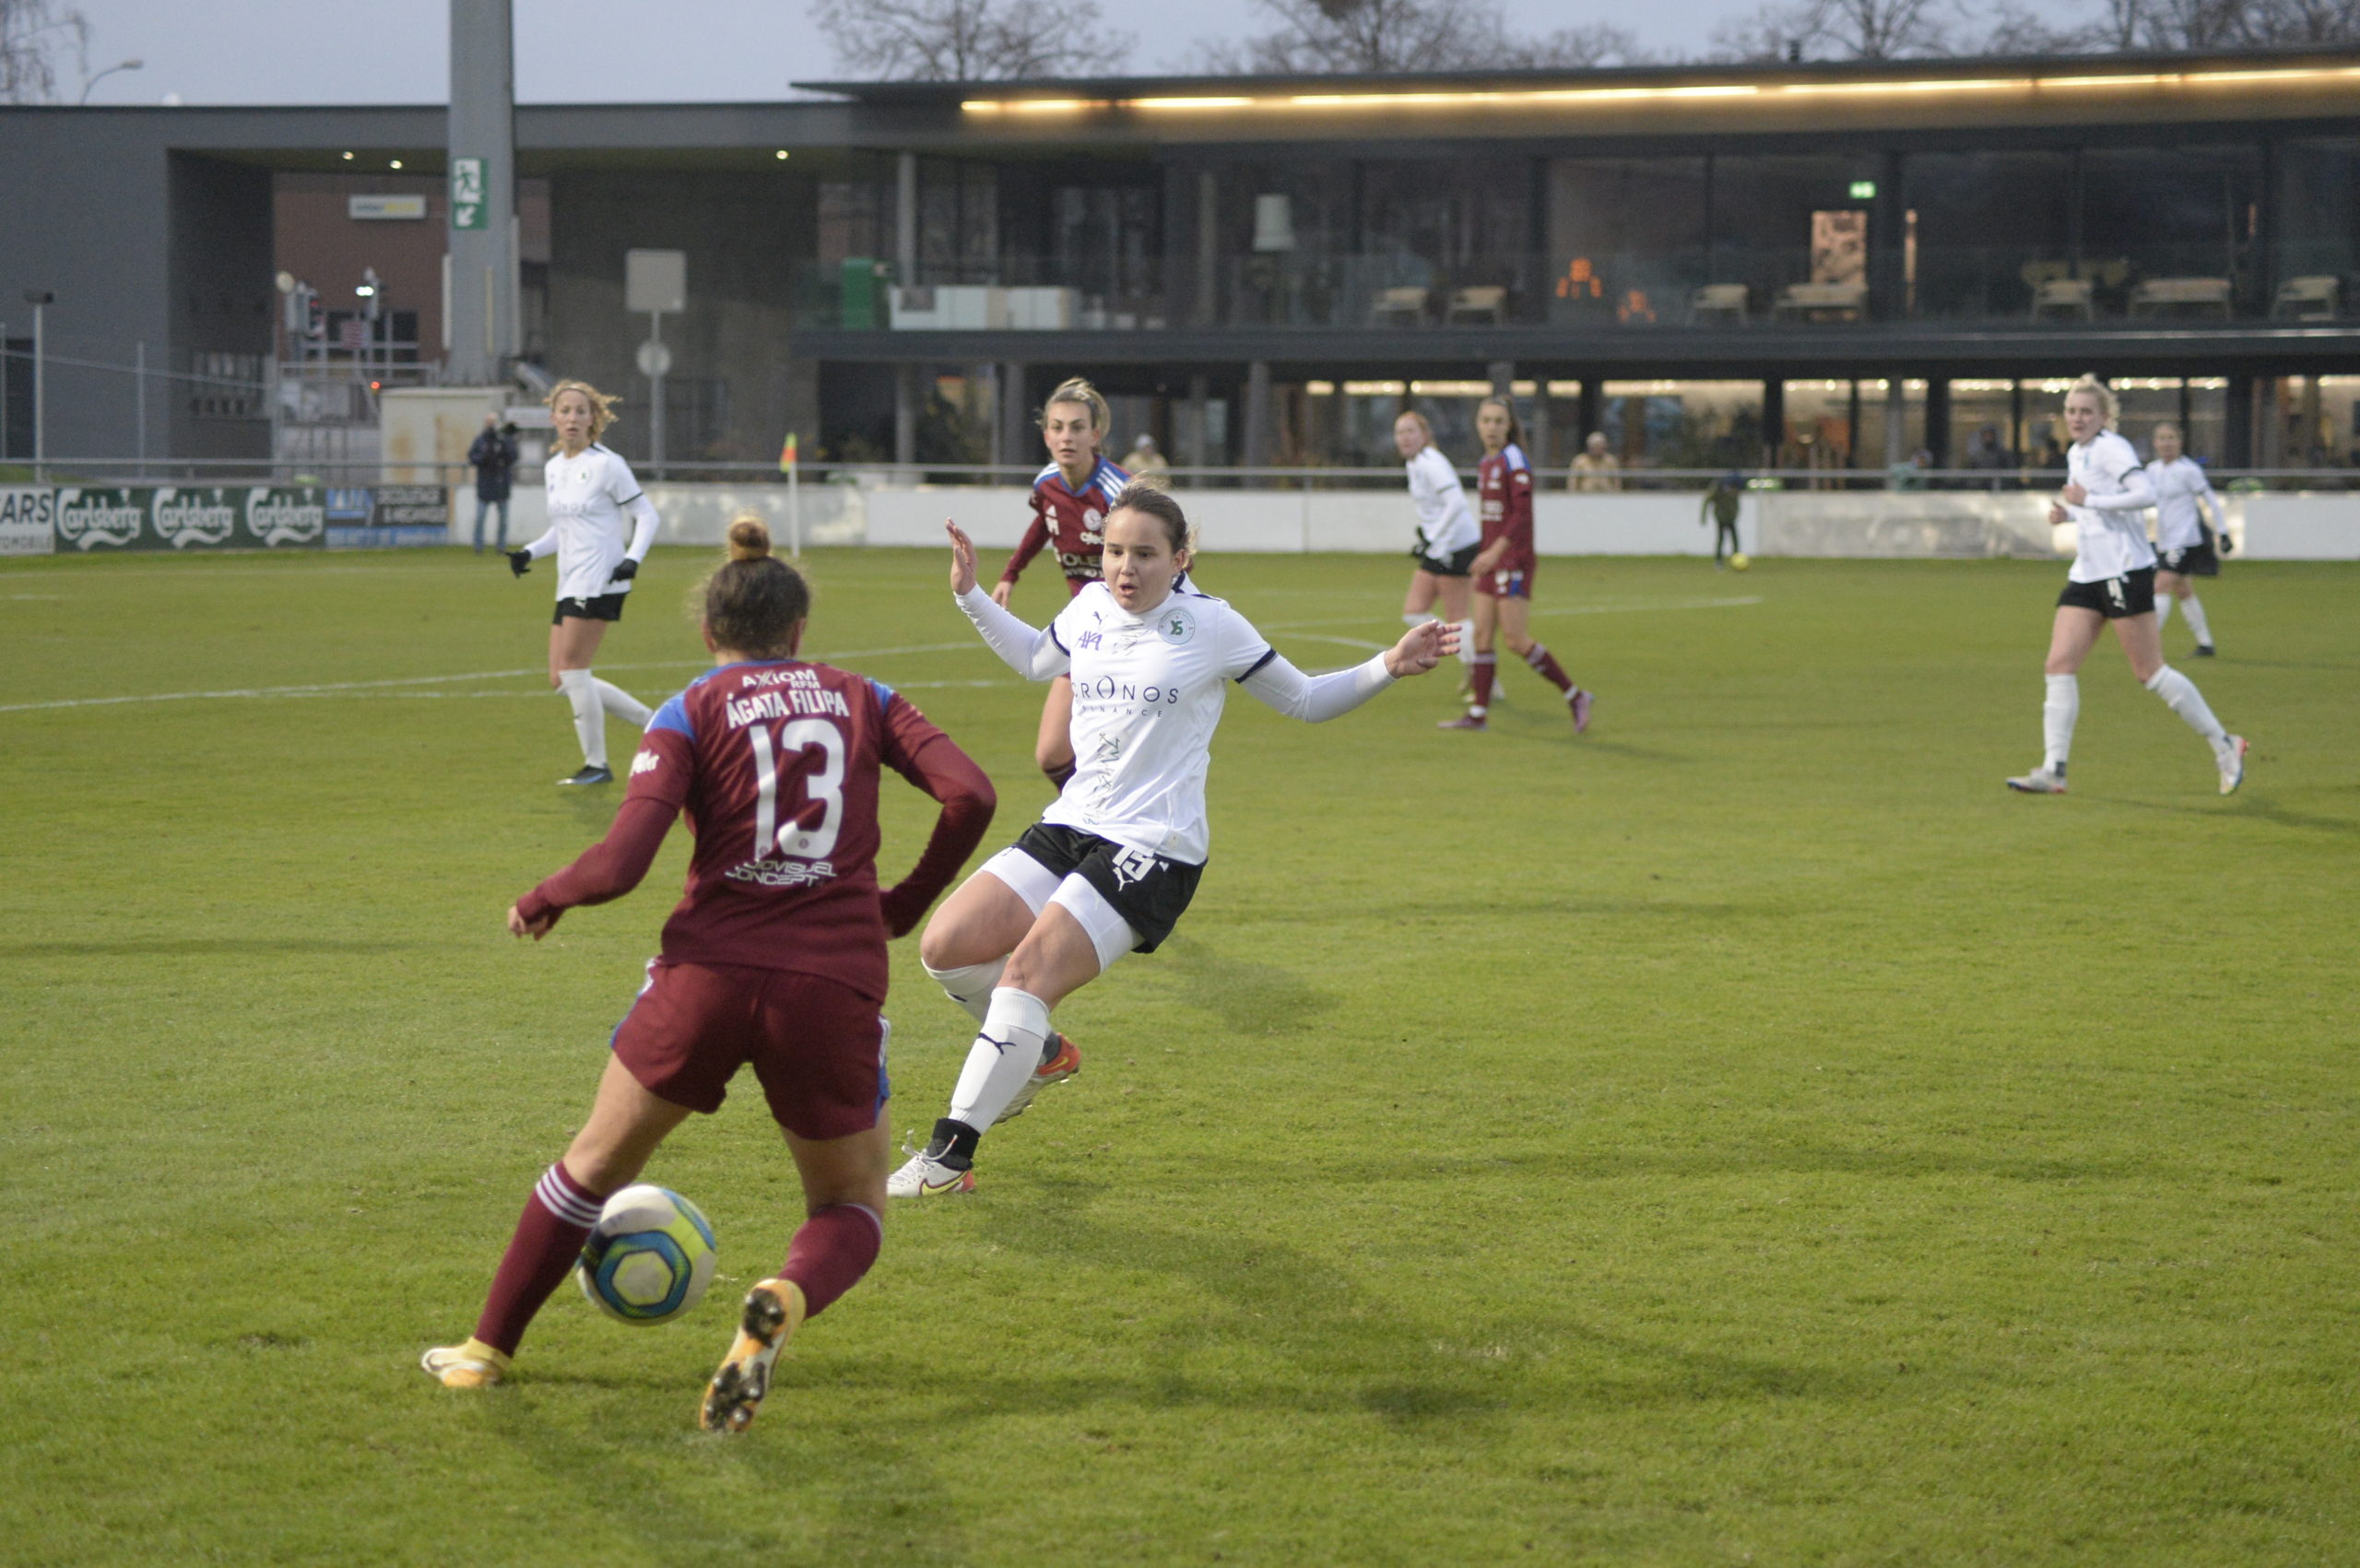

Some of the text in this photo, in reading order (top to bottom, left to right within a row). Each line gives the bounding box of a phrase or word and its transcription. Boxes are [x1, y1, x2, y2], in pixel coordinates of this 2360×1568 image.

[57, 488, 142, 550] Carlsberg
[153, 488, 233, 548] Carlsberg
[247, 488, 323, 546] Carlsberg
[742, 669, 818, 690] AXIOM
[726, 690, 850, 729] ÁGATA FILIPA
[749, 718, 844, 861] 13
